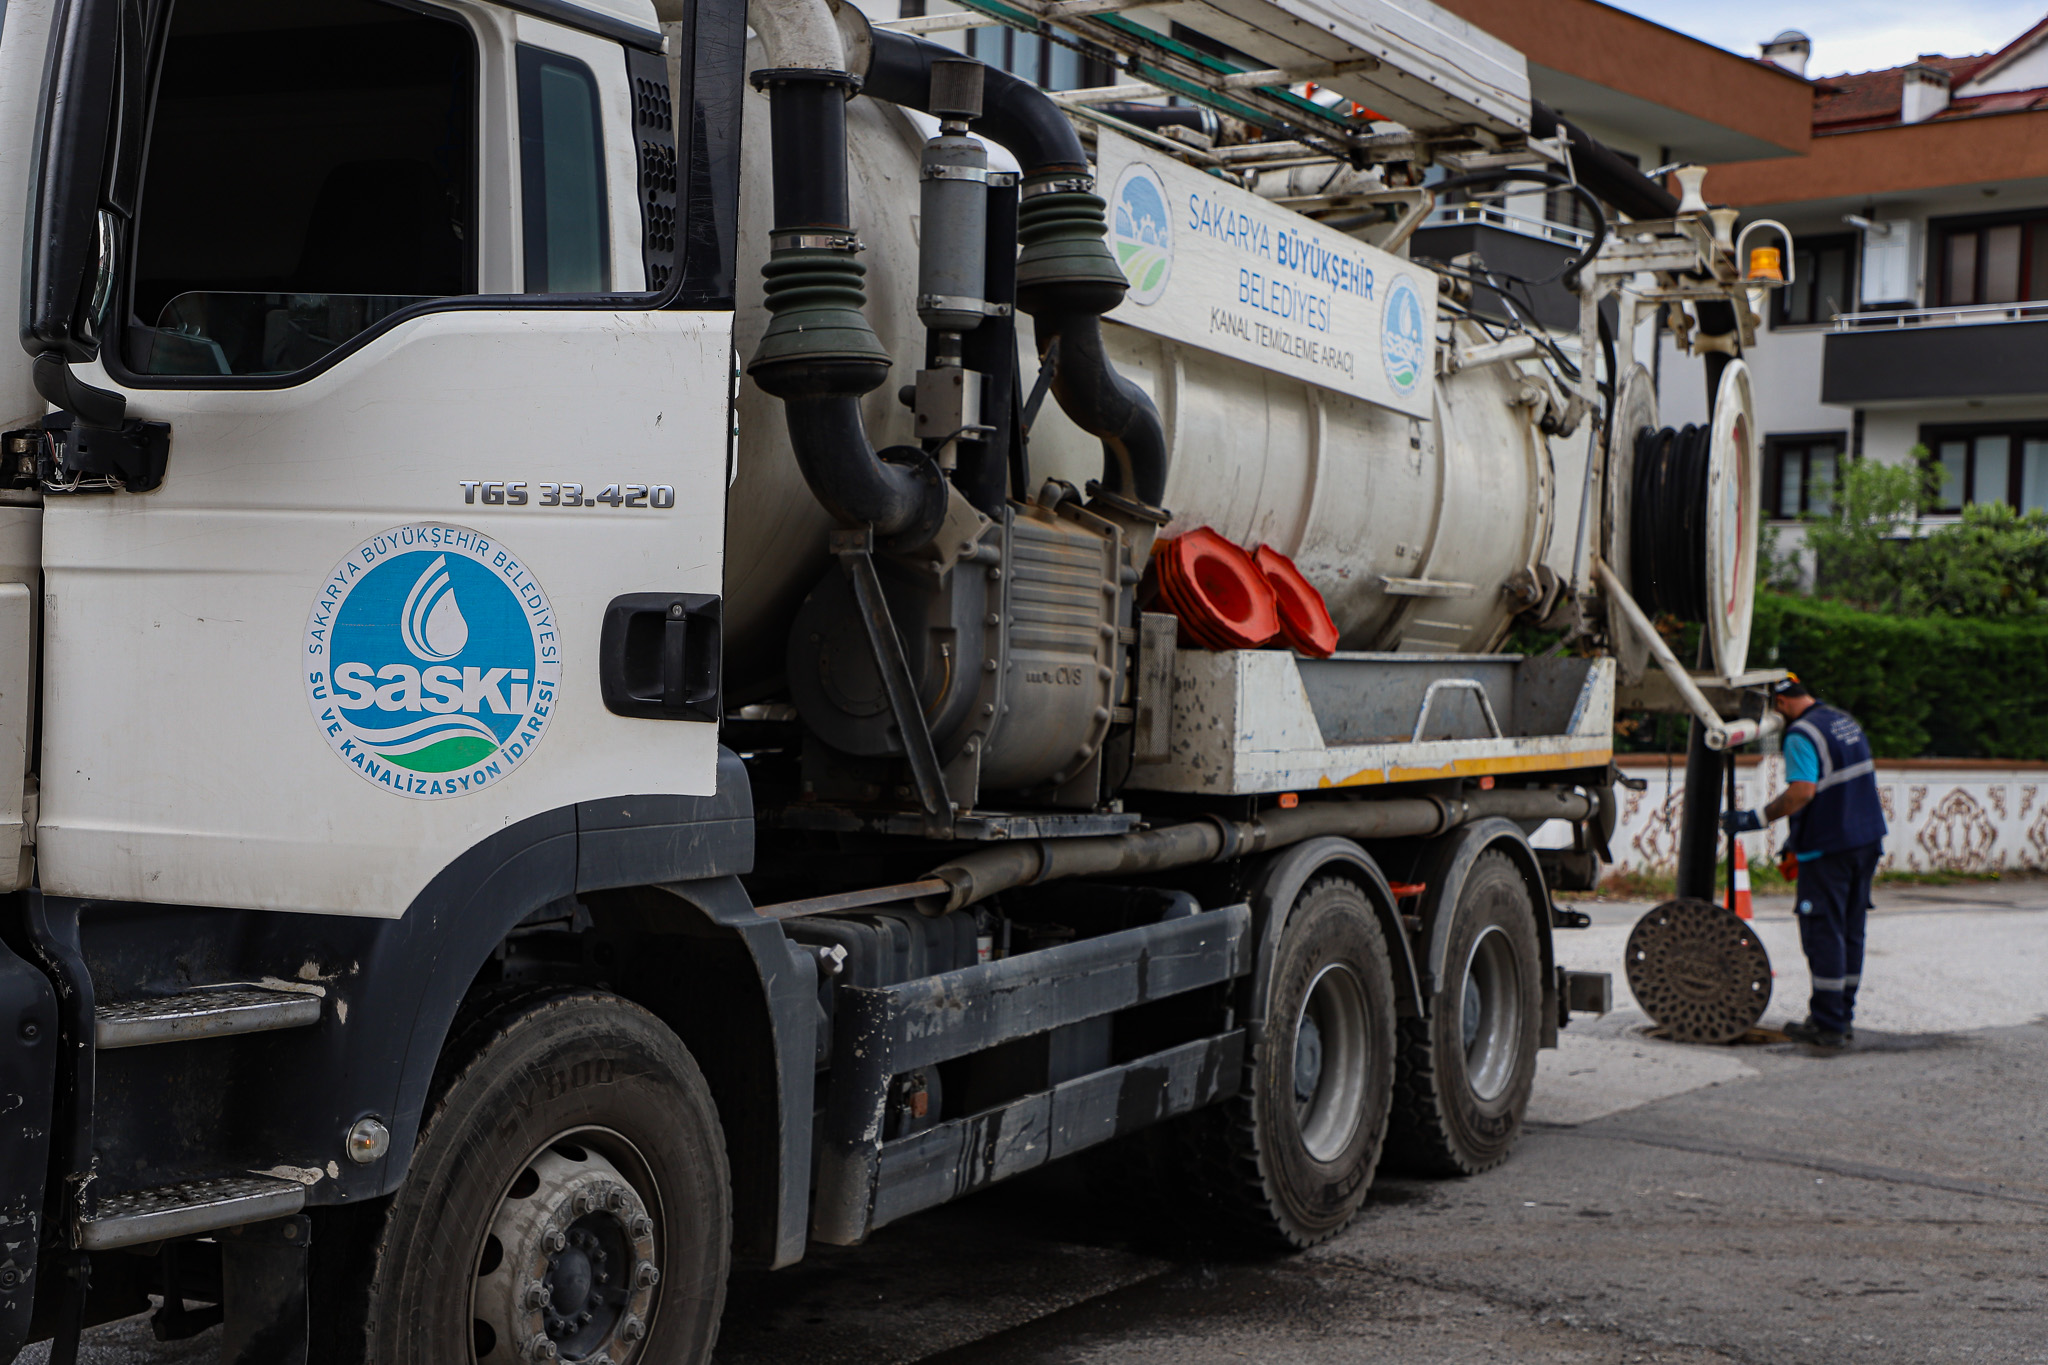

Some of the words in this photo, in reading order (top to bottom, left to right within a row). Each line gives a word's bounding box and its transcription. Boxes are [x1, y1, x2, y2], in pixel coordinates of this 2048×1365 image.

[1188, 193, 1270, 260] SAKARYA
[1277, 228, 1375, 301] BÜYÜKŞEHİR
[1210, 306, 1251, 342] KANAL
[1254, 321, 1319, 364] TEMİZLEME
[1238, 267, 1332, 334] BELEDİYESİ
[459, 480, 527, 505] TGS
[539, 482, 675, 508] 33.420
[308, 562, 361, 656] SAKARYA
[360, 526, 490, 564] BÜYÜKŞEHİR
[493, 550, 560, 665] BELEDİYESİ
[308, 670, 328, 700] SU
[321, 706, 343, 737] VE
[339, 739, 502, 796] KANALİZASYON
[500, 679, 556, 766] İDARESİ
